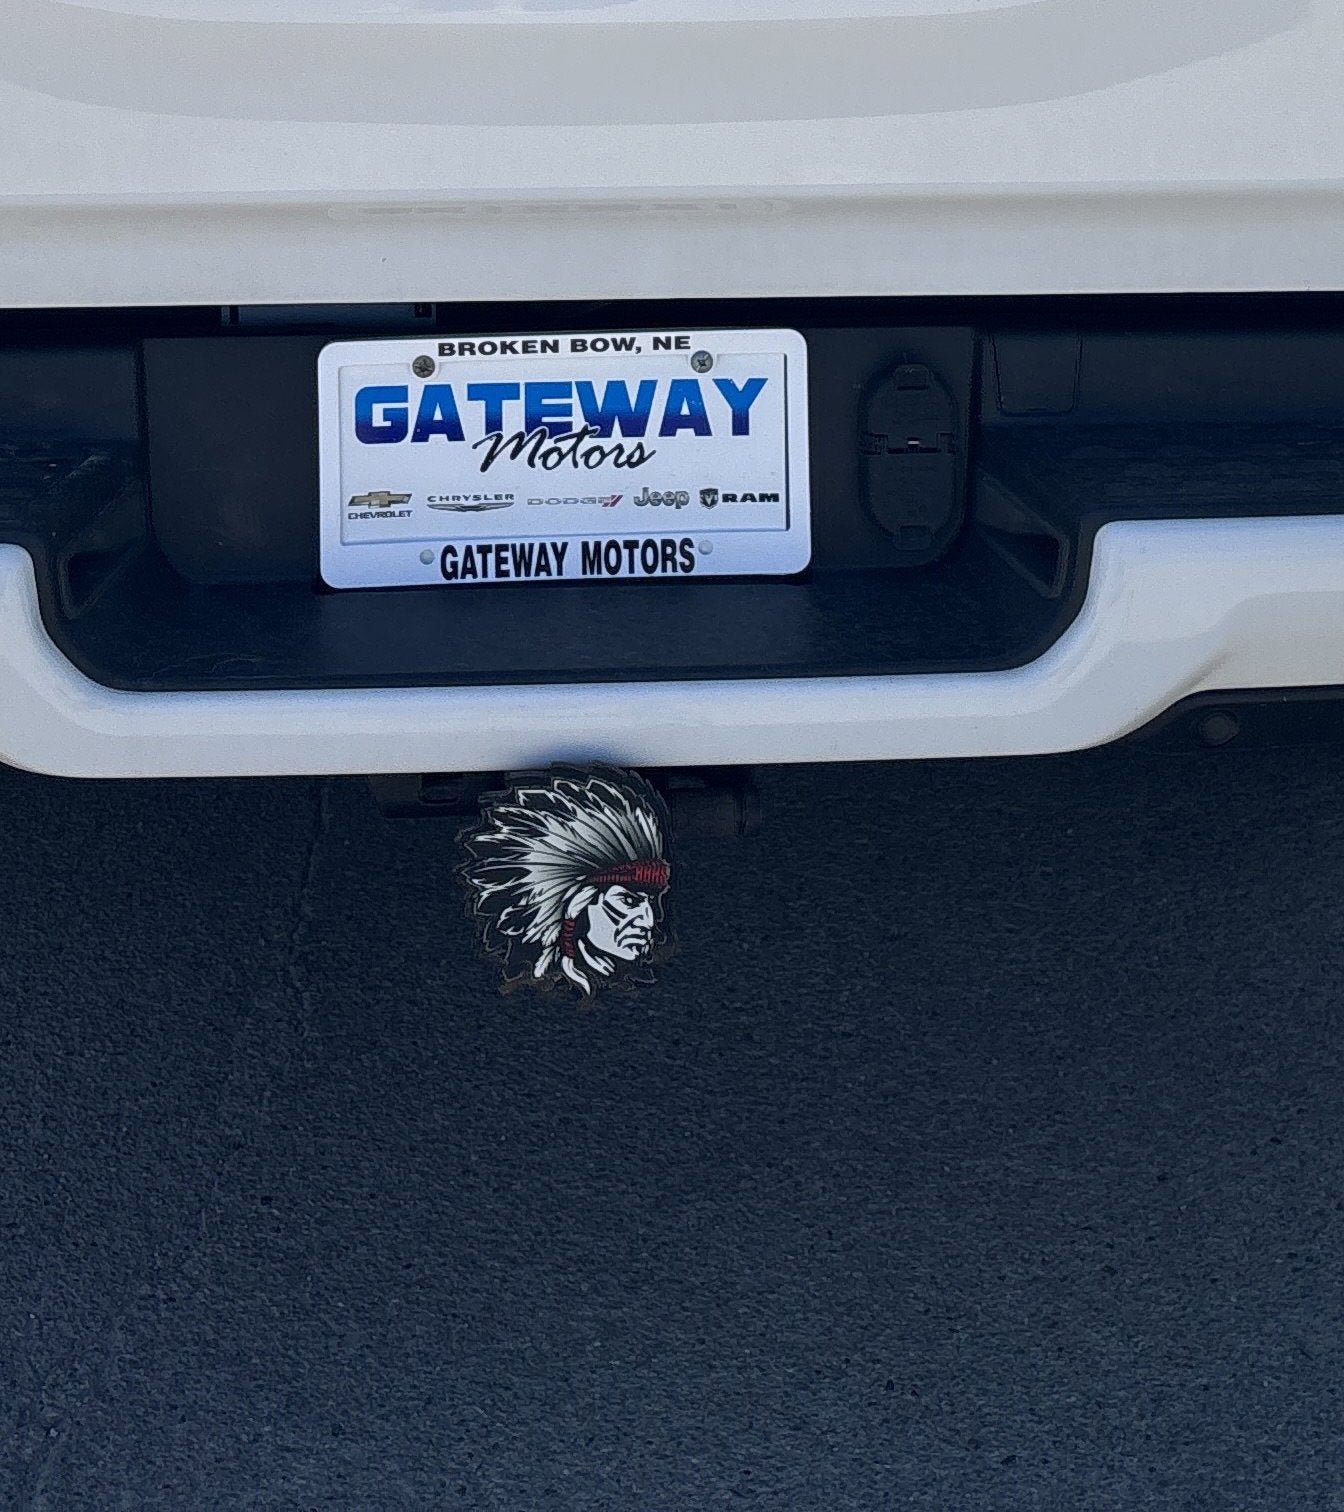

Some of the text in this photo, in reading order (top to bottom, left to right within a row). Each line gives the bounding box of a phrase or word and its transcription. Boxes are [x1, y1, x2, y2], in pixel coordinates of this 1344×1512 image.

[438, 335, 691, 357] BROKEN BOW, NE
[355, 377, 768, 444] GATEWAY
[472, 424, 656, 472] Motors
[427, 493, 515, 503] CHRYSLER
[633, 488, 690, 509] Jeep
[722, 492, 780, 503] RAM
[348, 510, 413, 520] CHEVROLET
[441, 538, 696, 581] GATEWAY MOTORS
